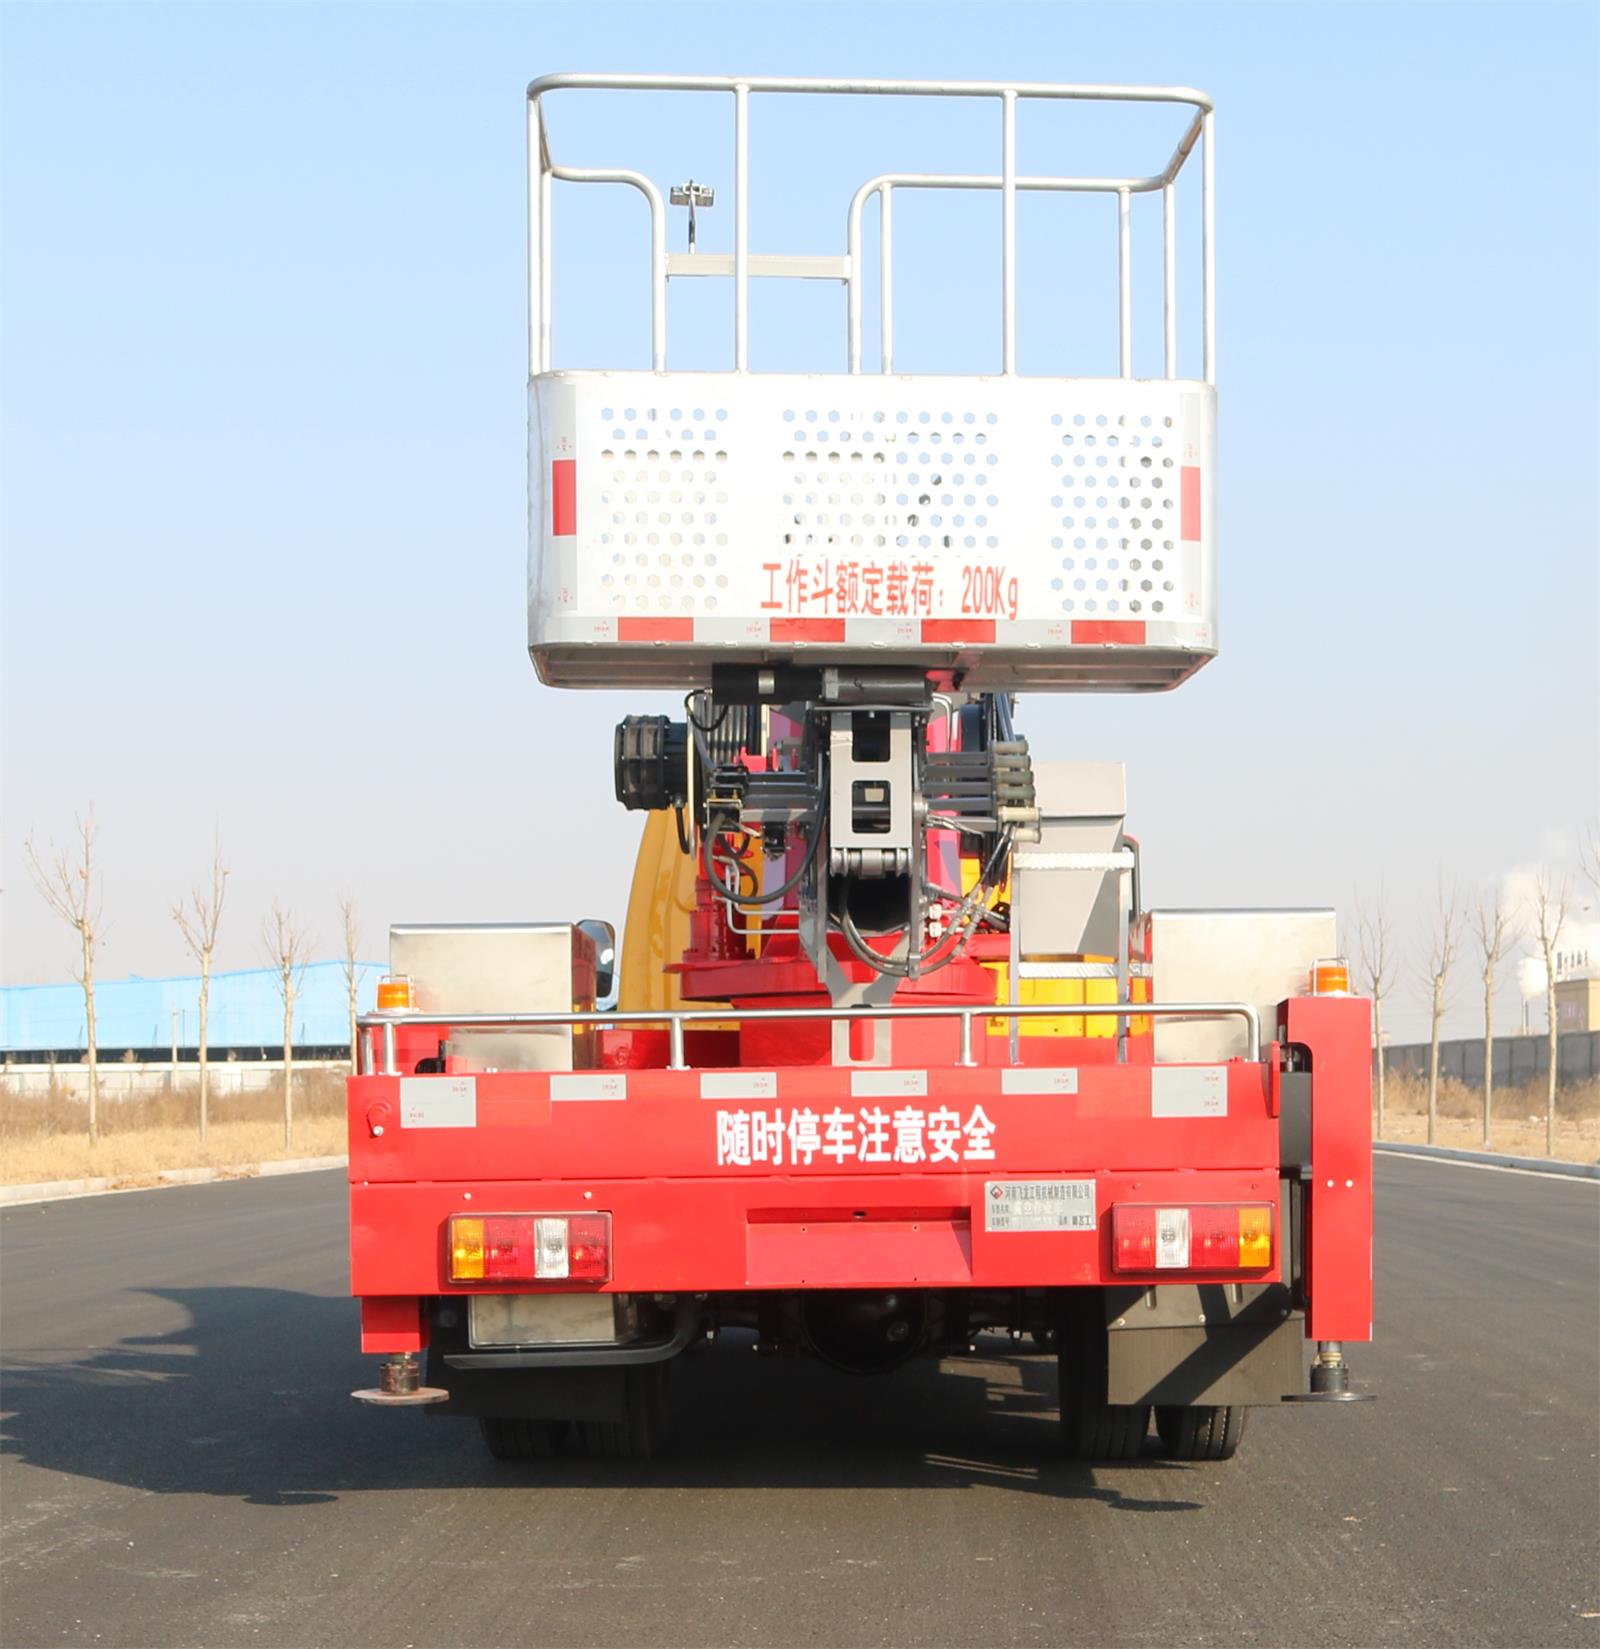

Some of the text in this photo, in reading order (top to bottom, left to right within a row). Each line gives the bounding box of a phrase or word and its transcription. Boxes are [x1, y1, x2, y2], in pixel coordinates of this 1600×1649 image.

[760, 559, 1018, 620] 工作斗额定载荷： 200Kg
[716, 1104, 996, 1166] 随时停车注意安全
